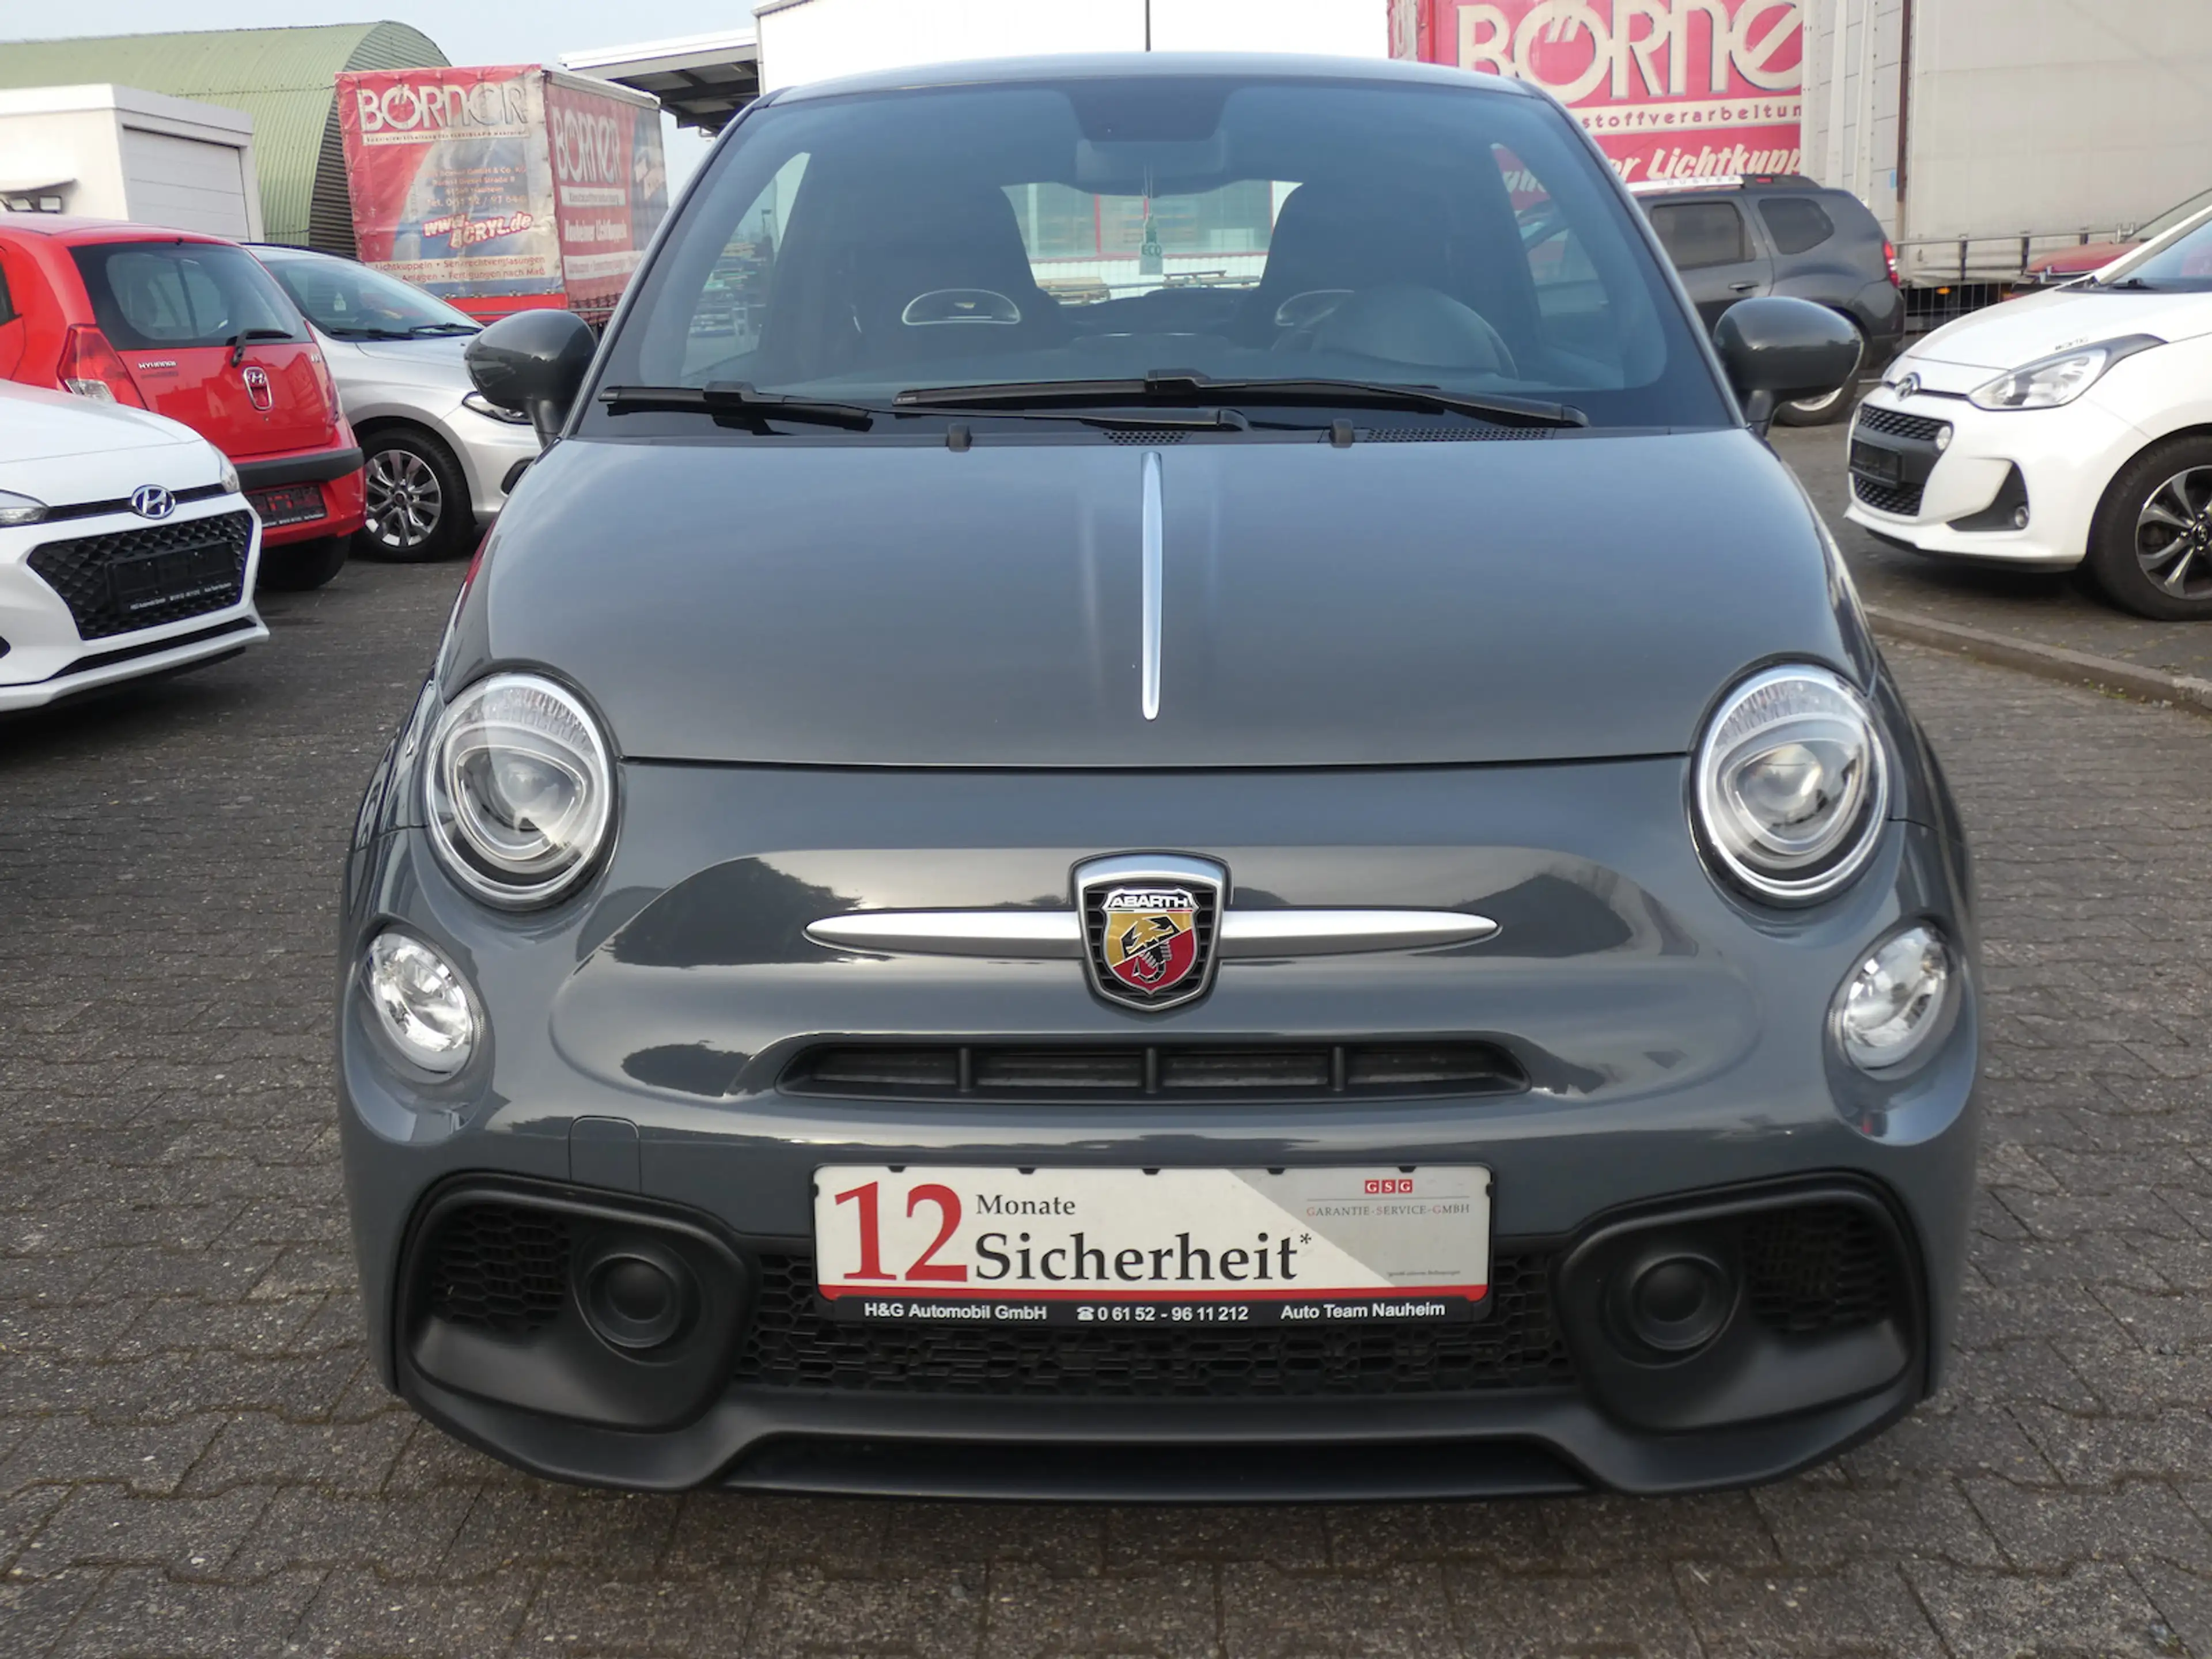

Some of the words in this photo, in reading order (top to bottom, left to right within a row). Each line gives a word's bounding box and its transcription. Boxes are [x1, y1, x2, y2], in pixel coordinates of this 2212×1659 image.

[1111, 895, 1188, 908] ABARTH
[1365, 1180, 1412, 1194] GSG
[976, 1194, 1075, 1215] Monate
[835, 1181, 968, 1282] 12
[865, 1302, 904, 1317] H&G
[908, 1304, 990, 1320] Automobil
[994, 1305, 1047, 1320] GmbH
[1281, 1305, 1320, 1320] Auto
[1323, 1304, 1368, 1319] Team
[1372, 1302, 1445, 1317] Nauheim
